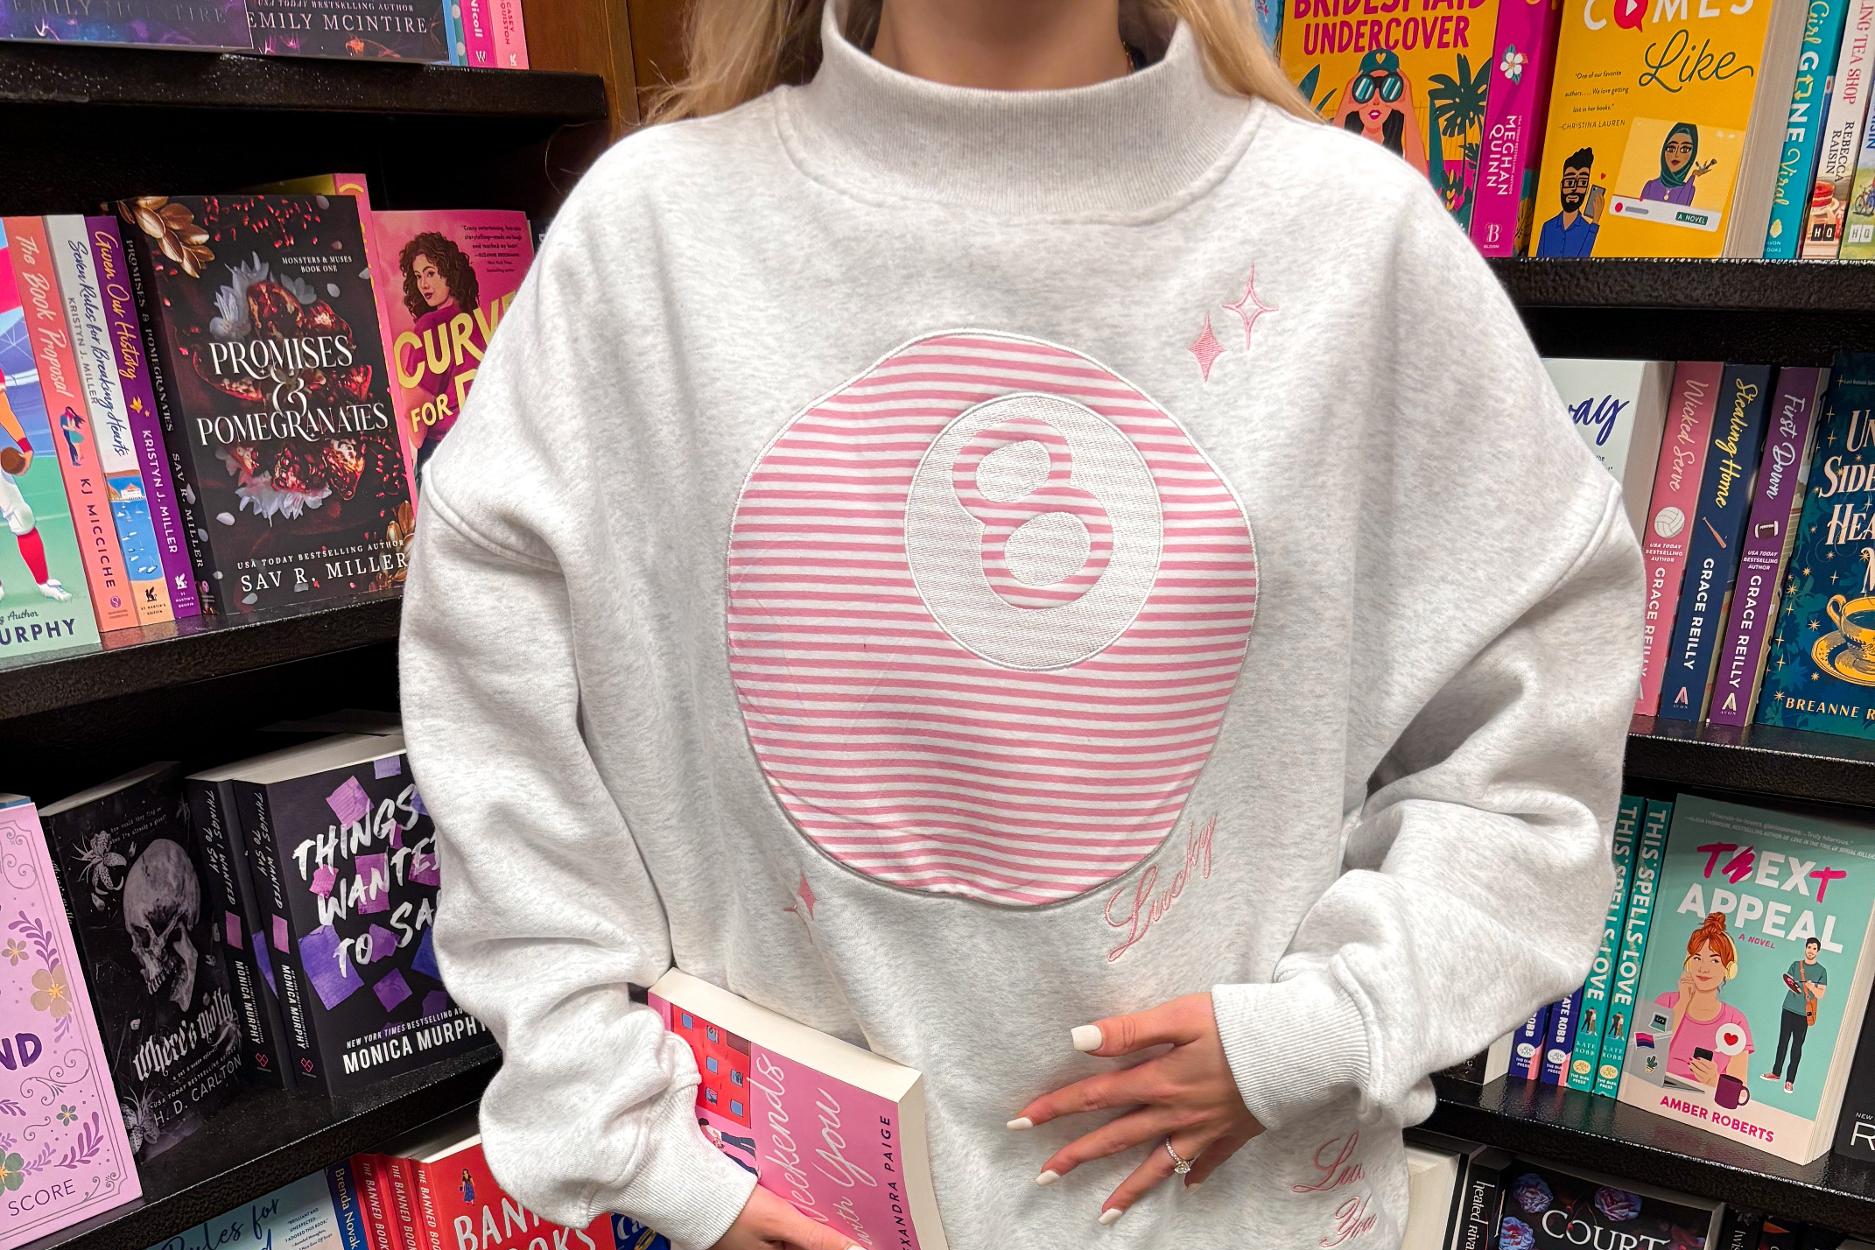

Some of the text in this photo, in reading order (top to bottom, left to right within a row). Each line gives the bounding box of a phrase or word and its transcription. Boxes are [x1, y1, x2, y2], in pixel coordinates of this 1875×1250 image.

[248, 11, 313, 31] EMILY
[323, 14, 428, 34] MCINTIRE
[1304, 15, 1469, 56] UNDERCOVER
[1639, 29, 1754, 94] Like
[1486, 124, 1503, 188] QUINN
[1498, 115, 1518, 195] MEGHAN
[1826, 130, 1842, 174] RAISIN
[1835, 121, 1854, 182] REBECCA
[282, 256, 320, 265] MONSTERS
[329, 255, 353, 264] MUSES
[301, 264, 338, 273] BOOK ONE
[15, 233, 75, 398] The Book Proposal
[94, 231, 137, 380] Given Our History
[210, 335, 354, 380] PROMISES
[273, 367, 307, 417] &
[197, 402, 389, 446] POMEGRANATES
[1669, 378, 1709, 492] Wicked Serve
[1714, 378, 1759, 509] Stealing Home
[80, 477, 115, 588] KJ MICCICHE
[237, 540, 405, 570] USA TODAY BESTSELLING AUTHOR
[241, 552, 408, 592] SAV R. MILLER
[1684, 558, 1714, 671] GRACE REILLY
[293, 785, 418, 880] THINGS
[1104, 814, 1216, 963] Lucky
[1624, 868, 1656, 947] SPELLS
[1676, 883, 1844, 954] APPEAL
[1738, 934, 1775, 949] A NOVEL
[1614, 950, 1639, 1006] LOVE
[342, 1036, 413, 1075] MONICA
[880, 1115, 893, 1172] PAIGE
[1660, 1096, 1775, 1143] AMBER ROBERTS
[8, 1179, 76, 1217] SCORE
[251, 1197, 282, 1239] for
